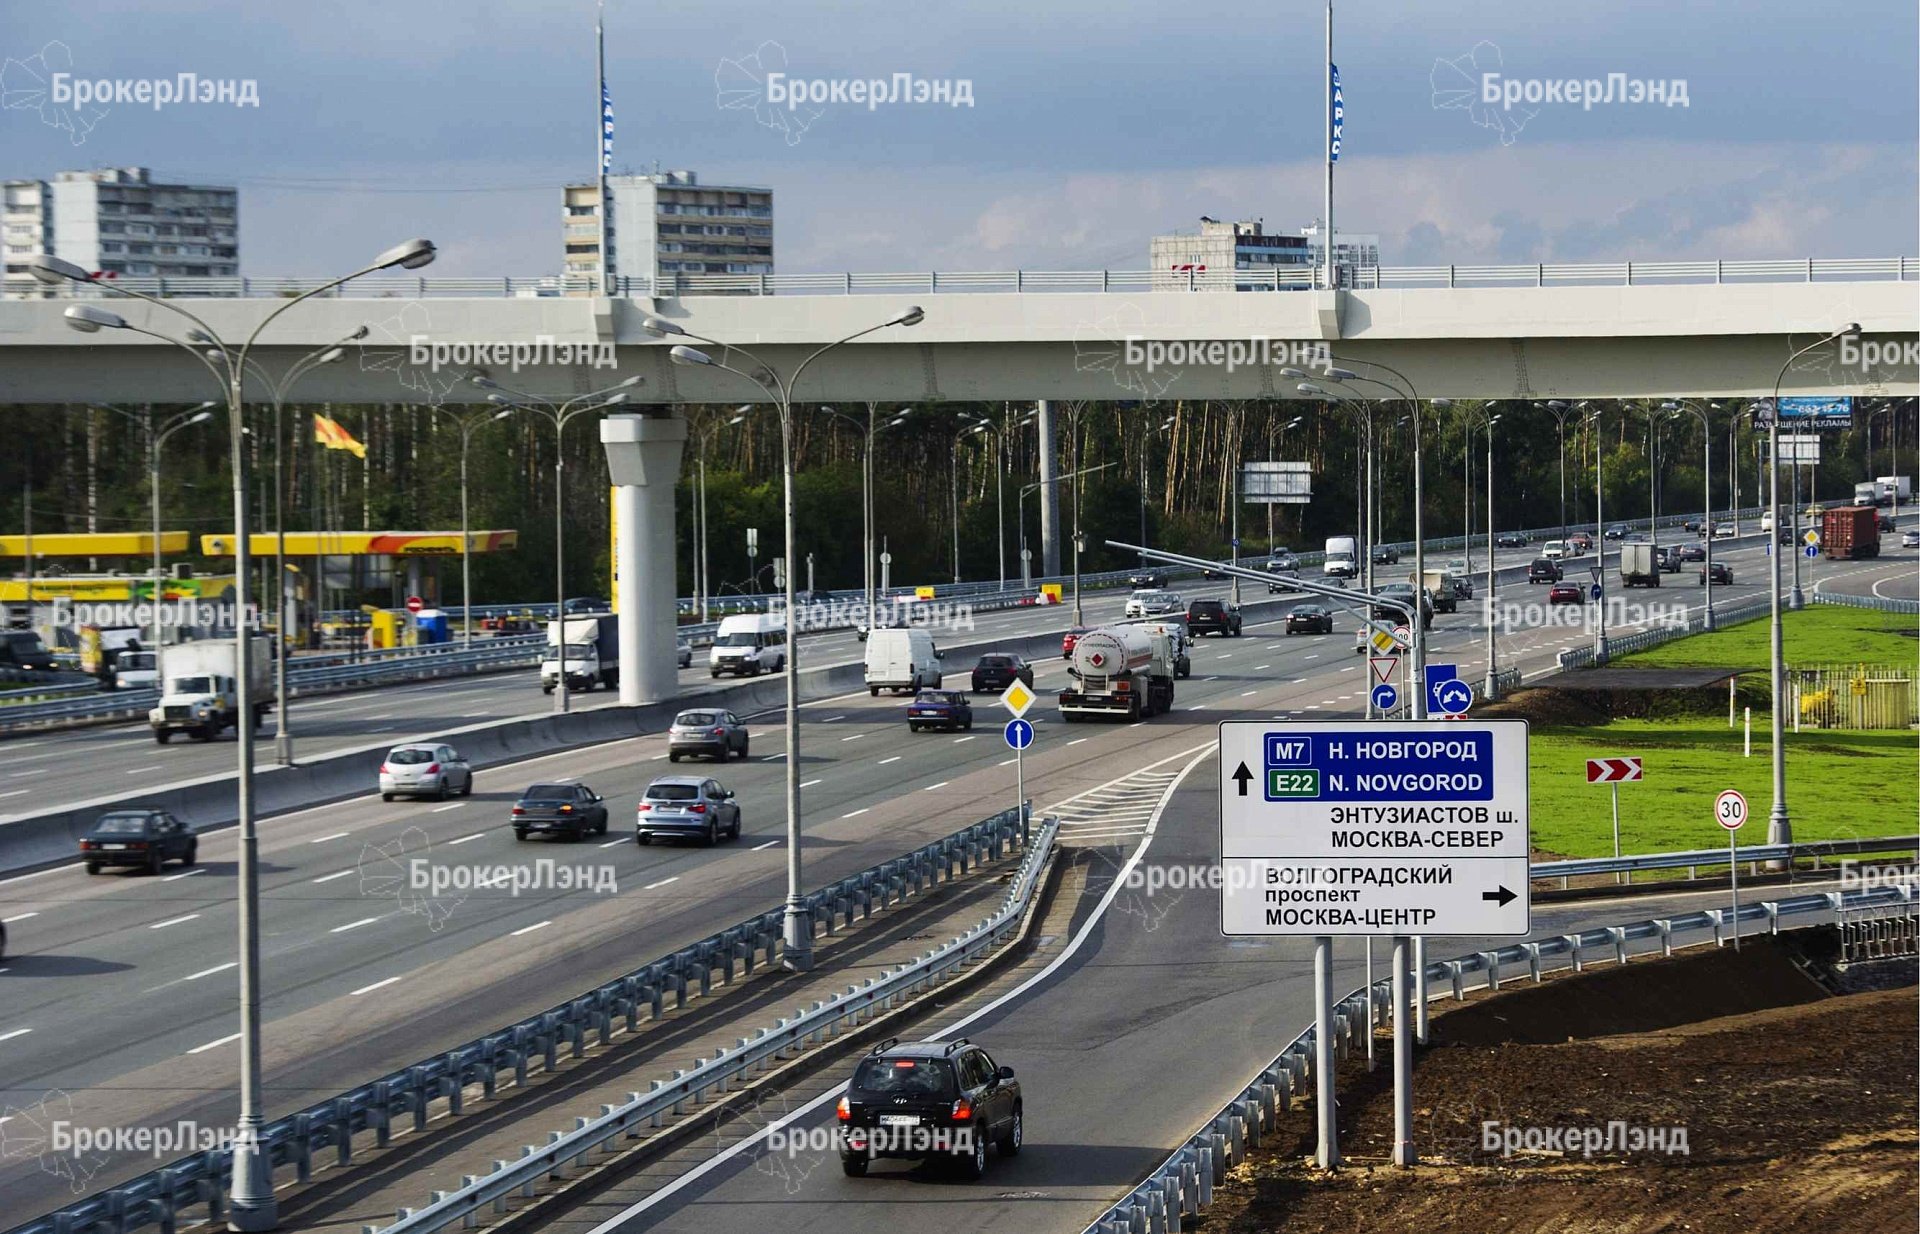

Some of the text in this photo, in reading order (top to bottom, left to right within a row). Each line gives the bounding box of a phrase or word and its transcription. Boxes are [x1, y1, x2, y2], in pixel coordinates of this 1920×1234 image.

[1329, 741, 1477, 761] Н. НОВГОРОД
[1276, 775, 1314, 792] E22
[1329, 774, 1483, 792] N. NOVGOROD
[1331, 807, 1519, 824] ЭНТУЗИАСТОВ ш.
[1721, 801, 1741, 818] 30
[1331, 831, 1504, 848] МОСКВА-СЕВЕР
[1266, 864, 1452, 887] ВОЛГОГРАДСКИЙ
[1265, 889, 1360, 906] проспект
[1266, 909, 1436, 928] МОСКВА-ЦЕНТР
